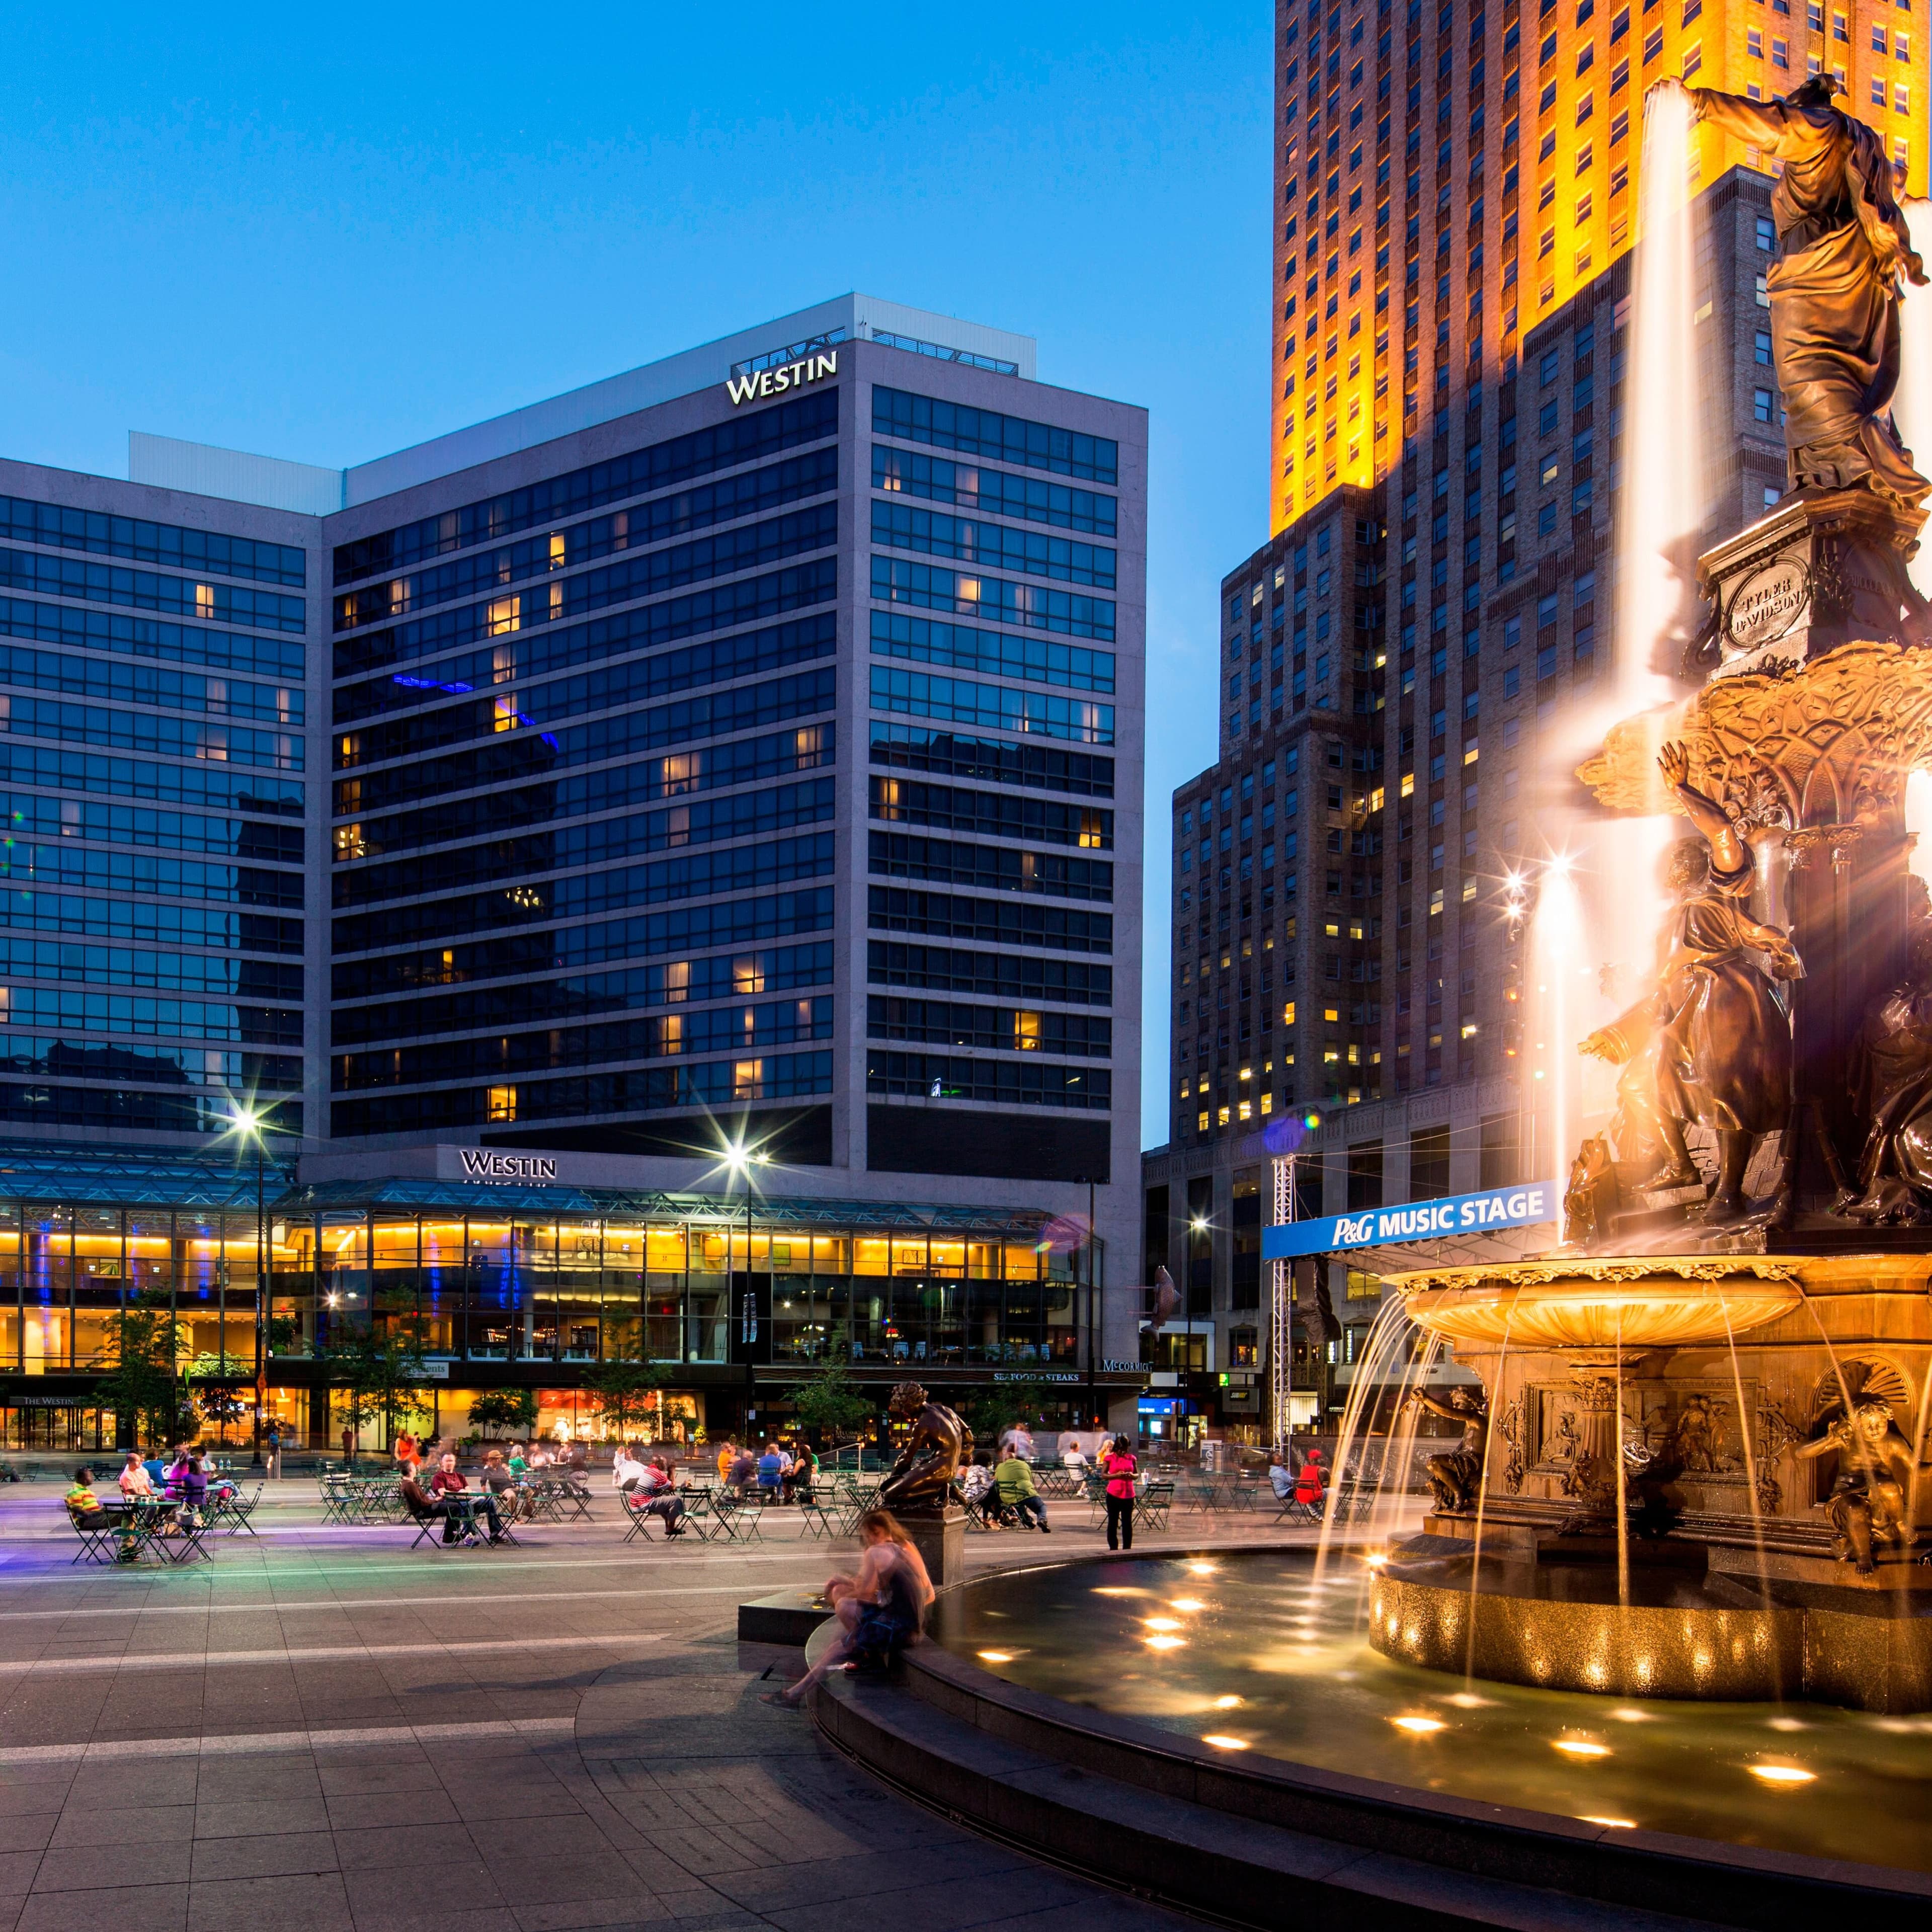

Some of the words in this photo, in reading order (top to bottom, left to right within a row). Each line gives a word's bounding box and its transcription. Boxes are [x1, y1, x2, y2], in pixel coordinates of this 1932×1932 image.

[726, 350, 837, 406] WESTIN
[1735, 591, 1800, 635] DAVIDSON
[1742, 579, 1791, 612] TYLER
[460, 1150, 556, 1178] WESTIN
[1332, 1214, 1375, 1246] P&G
[1379, 1205, 1454, 1237] MUSIC
[1461, 1190, 1544, 1226] STAGE
